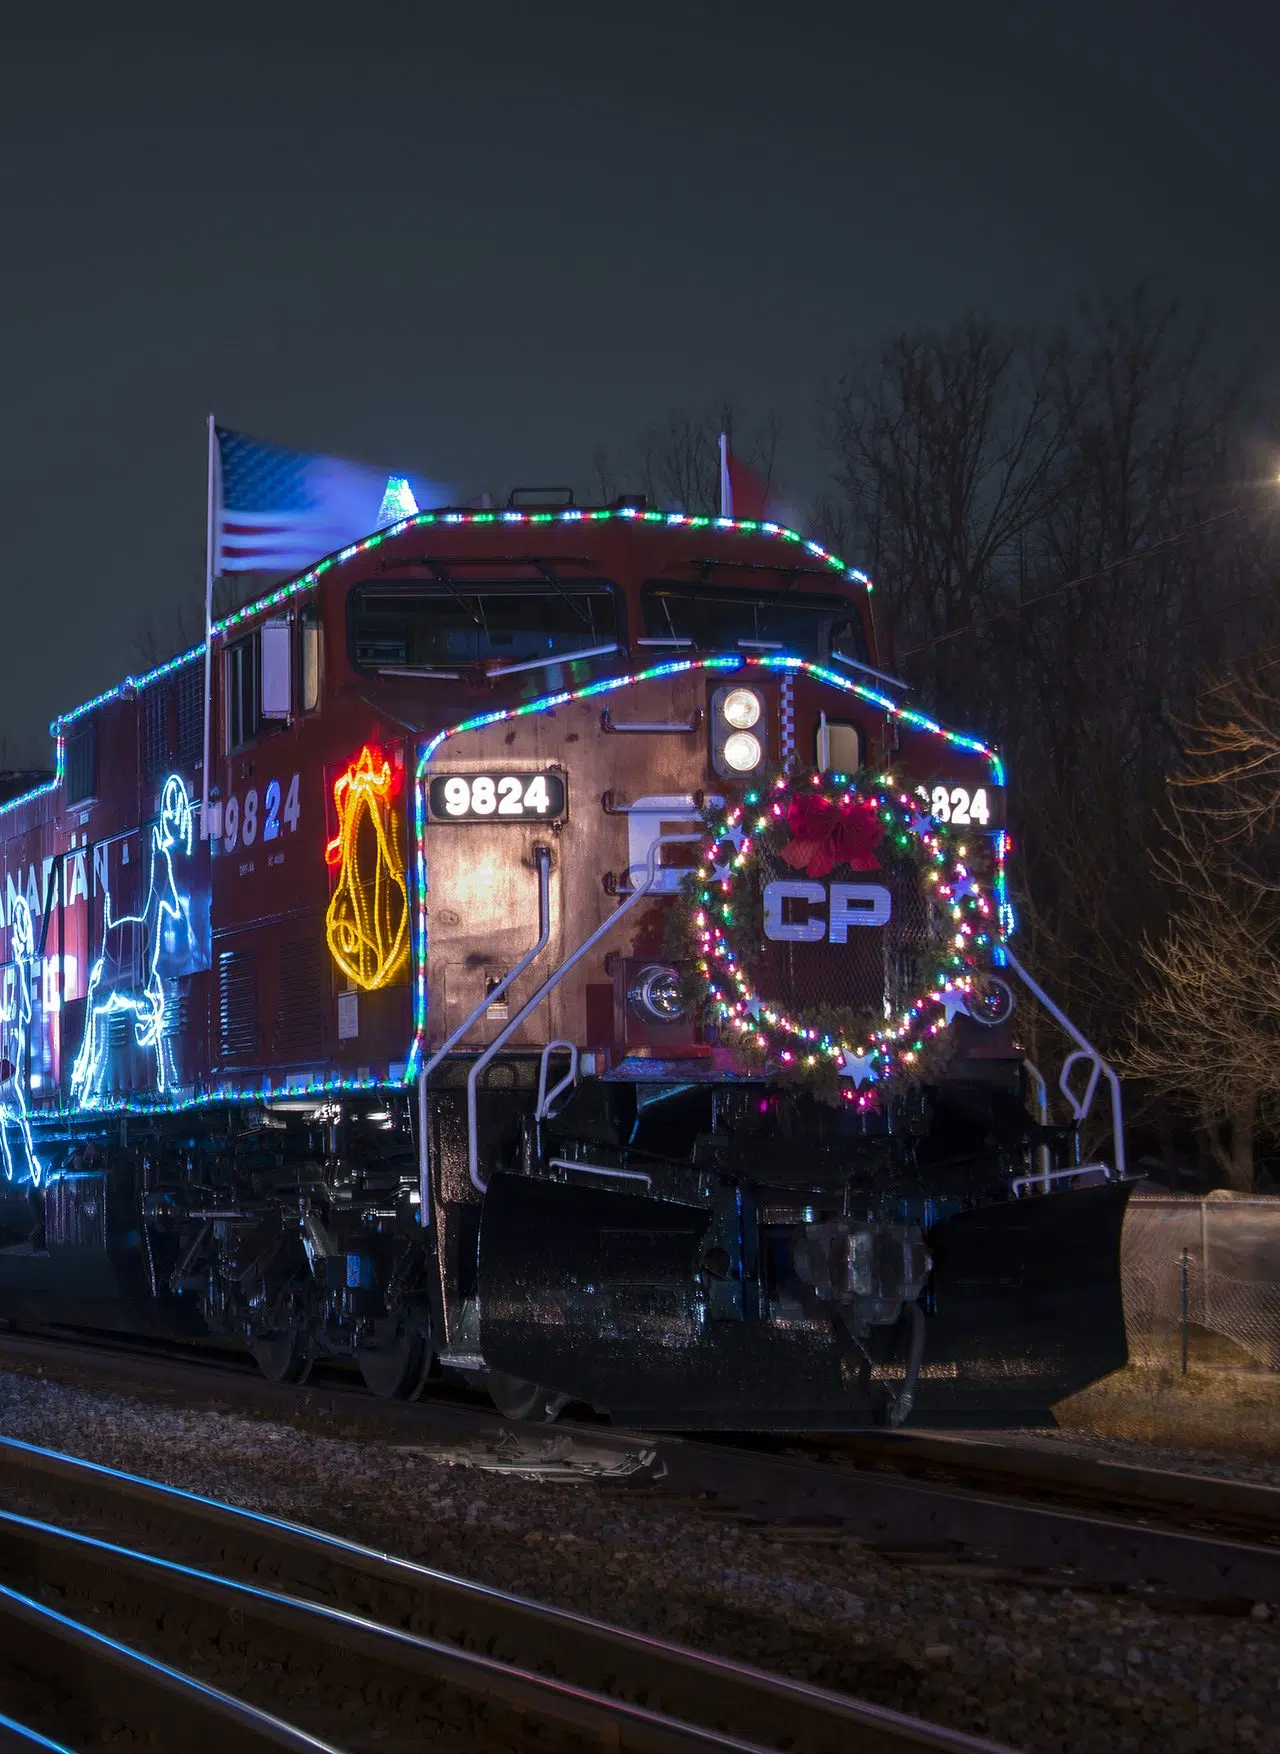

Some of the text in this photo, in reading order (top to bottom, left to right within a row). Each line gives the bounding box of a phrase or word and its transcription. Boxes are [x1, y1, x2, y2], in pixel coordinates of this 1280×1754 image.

[225, 773, 300, 853] 9824
[444, 776, 549, 816] 9824
[763, 881, 892, 943] CP
